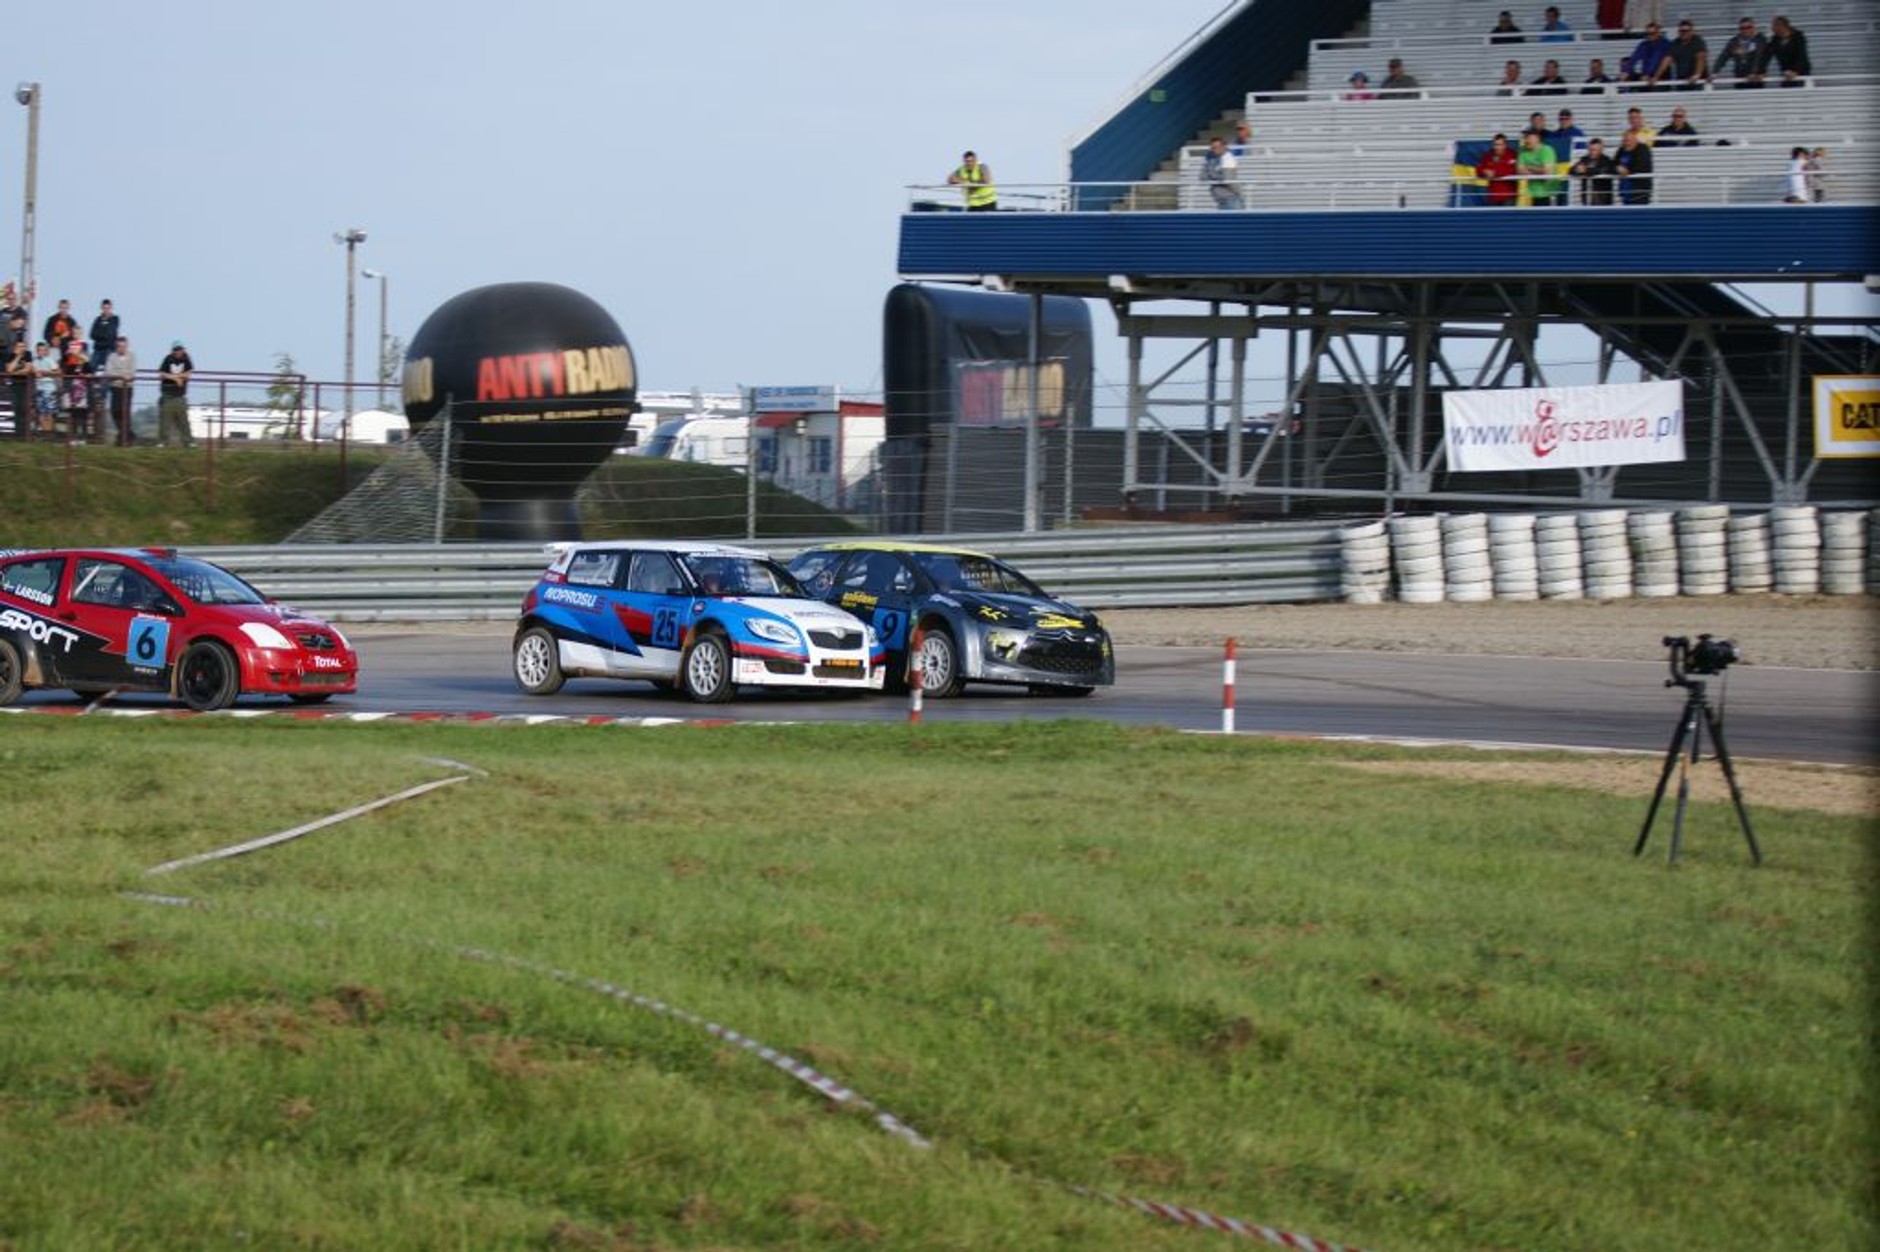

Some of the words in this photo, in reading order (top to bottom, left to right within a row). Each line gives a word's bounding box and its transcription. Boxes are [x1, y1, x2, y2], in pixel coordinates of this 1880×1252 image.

[1842, 403, 1880, 429] CAT
[656, 610, 677, 643] 25
[881, 612, 898, 643] 9
[136, 626, 156, 660] 6
